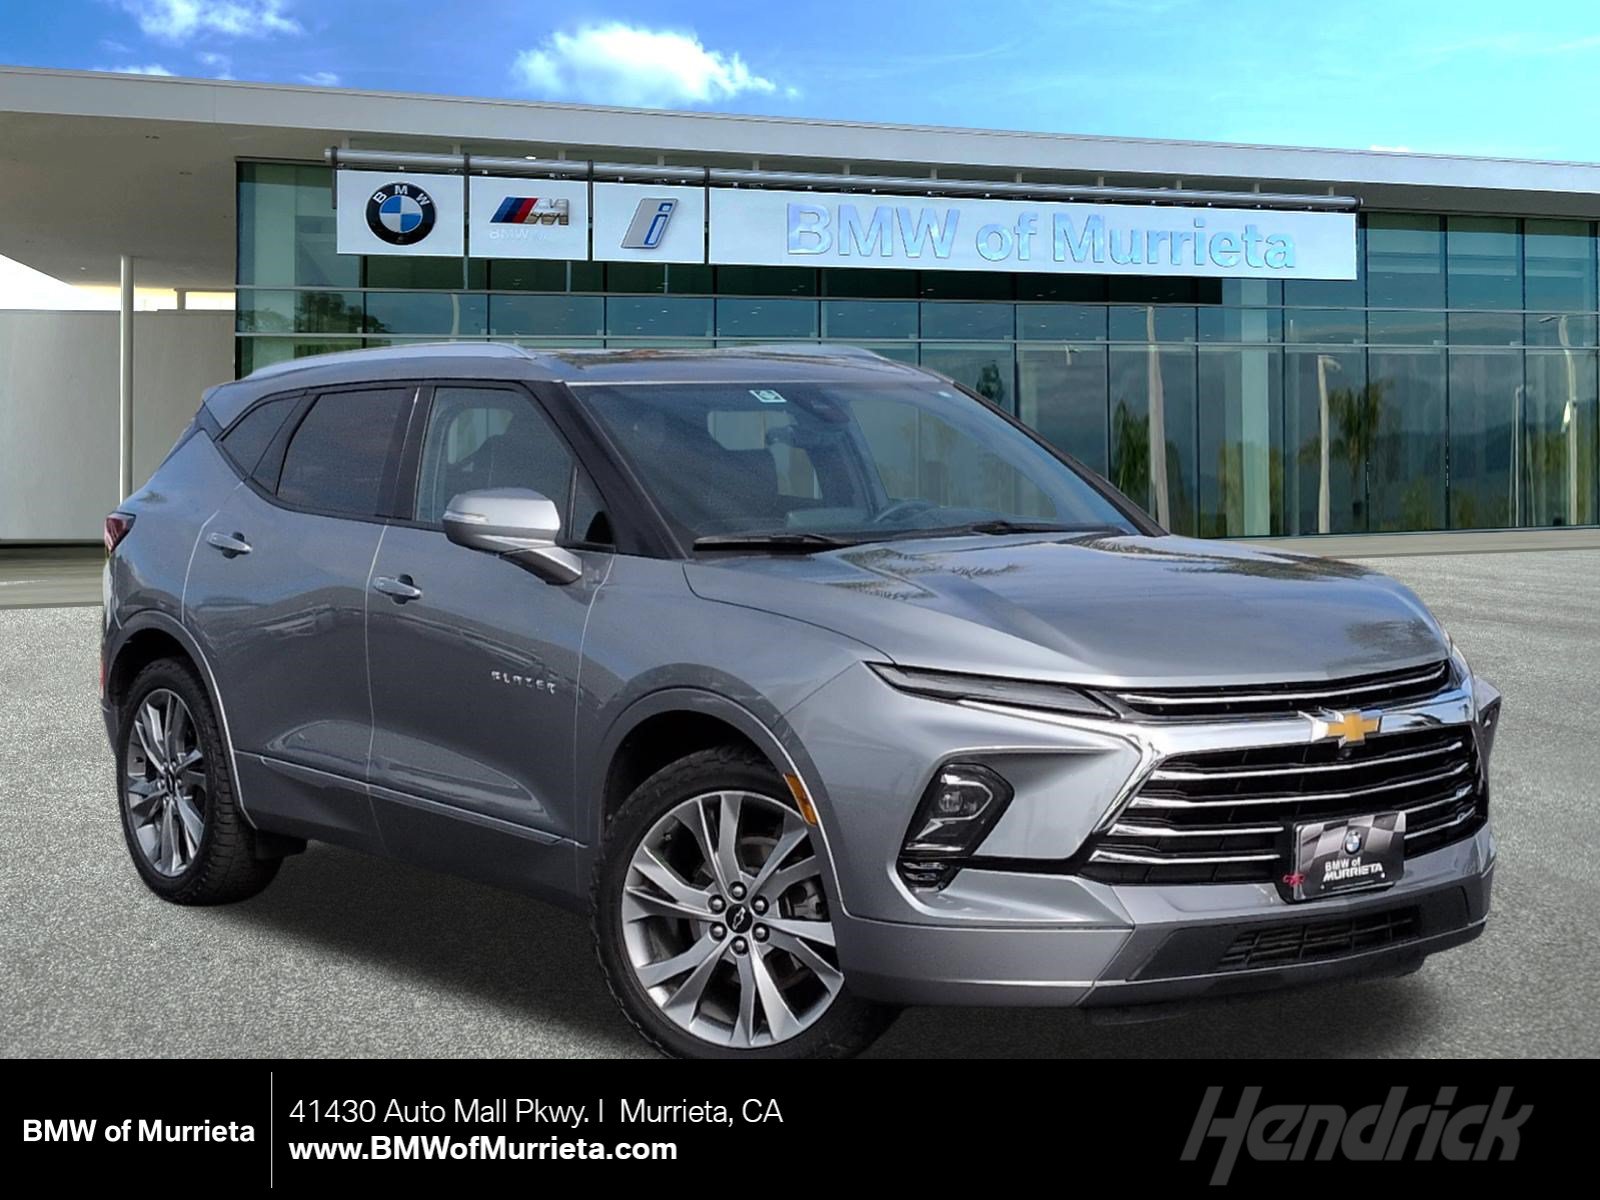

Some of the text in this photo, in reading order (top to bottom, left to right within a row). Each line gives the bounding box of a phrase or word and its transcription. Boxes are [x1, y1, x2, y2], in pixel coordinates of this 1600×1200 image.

[372, 184, 431, 206] BMW
[786, 203, 1296, 270] BMW of Murrieta
[1323, 862, 1384, 882] MURRIETA
[1324, 857, 1361, 872] BMW of
